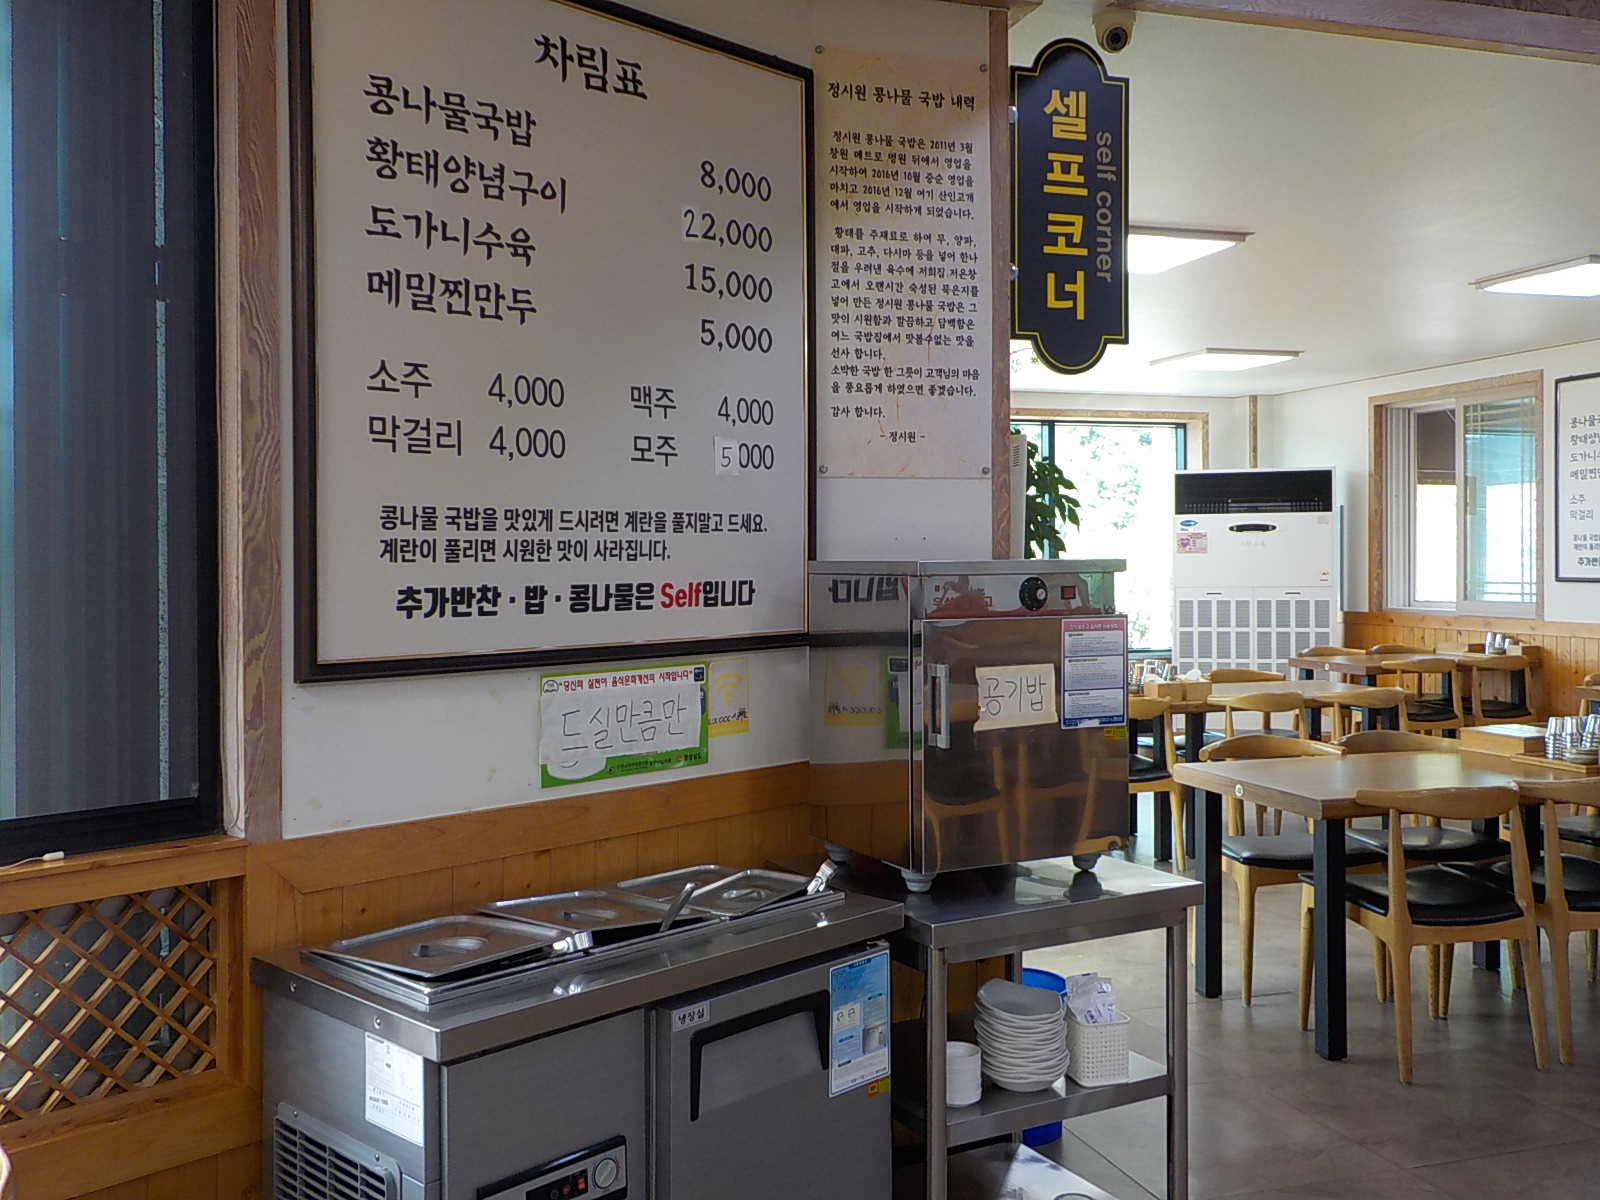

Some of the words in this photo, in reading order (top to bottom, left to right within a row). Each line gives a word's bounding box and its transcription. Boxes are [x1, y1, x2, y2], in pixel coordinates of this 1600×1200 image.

[534, 32, 648, 100] 차림표
[827, 82, 866, 101] 정시원
[873, 86, 913, 106] 콩나물
[919, 92, 945, 108] 국밥
[951, 95, 974, 111] 내력
[363, 73, 537, 148] 콩나물국밥
[832, 131, 861, 144] 정시원
[865, 135, 893, 147] 콩나물
[897, 137, 926, 149] 국밥은
[930, 140, 956, 153] 2011년
[960, 142, 973, 154] 3월
[829, 147, 848, 160] 창원
[854, 150, 883, 162] 메트로
[888, 152, 906, 165] 병원
[911, 155, 939, 167] 뒤에서
[944, 157, 972, 170] 영업을
[1096, 131, 1117, 183] self
[365, 136, 567, 214] 황태양념구이
[699, 159, 772, 203] 8,000
[829, 165, 867, 178] 시작하여
[872, 169, 899, 181] 2016년
[904, 171, 920, 183] 10월
[925, 173, 943, 185] 중순
[948, 174, 974, 187] 영업을
[829, 182, 858, 194] 마치고
[863, 185, 890, 197] 2016년
[895, 187, 912, 199] 12월
[917, 189, 933, 202] 여기
[938, 192, 974, 204] 산인고개
[1043, 89, 1089, 321] 셀프코너
[830, 199, 848, 211] 에서
[853, 201, 881, 214] 영업을
[885, 203, 922, 216] 시작하게
[926, 206, 974, 220] 되었습니다.
[364, 204, 536, 268] 도가니수육
[683, 208, 773, 253] 22,000
[834, 226, 864, 240] 황태를
[869, 229, 908, 242] 주재료로
[913, 232, 932, 245] 하여
[937, 234, 949, 246] 무,
[954, 234, 976, 248] 양파,
[1096, 190, 1113, 283] corner
[830, 244, 853, 257] 대파,
[857, 246, 879, 258] 고추,
[884, 247, 911, 260] 다시마
[916, 249, 934, 261] 등을
[939, 250, 955, 263] 넣어
[960, 252, 978, 264] 한나
[830, 261, 849, 273] 절을
[854, 262, 882, 275] 우려낸
[886, 264, 914, 277] 육수에
[919, 266, 945, 279] 저희집
[949, 268, 977, 280] 저온창
[684, 262, 773, 304] 15,000
[831, 278, 860, 291] 고에서
[865, 281, 904, 294] 오랜시간
[909, 283, 937, 295] 숙성된
[942, 285, 979, 298] 묵은지를
[366, 267, 538, 326] 메밀찐만두
[831, 296, 848, 308] 넣어
[853, 297, 872, 309] 만든
[876, 299, 902, 310] 정시원
[906, 301, 933, 312] 콩나물
[938, 301, 965, 314] 국밥은
[968, 303, 978, 313] 그
[831, 313, 850, 325] 맛의
[854, 315, 892, 326] 시원함과
[896, 316, 934, 328] 깔끔하고
[938, 318, 975, 331] 담백함은
[700, 318, 773, 354] 5,000
[831, 330, 850, 342] 어느
[854, 331, 900, 344] 국밥집에서
[906, 333, 951, 346] 맛볼수없는
[956, 336, 974, 348] 맛을
[831, 348, 850, 359] 선사
[854, 348, 886, 360] 합니다.
[365, 358, 433, 399] 소주
[487, 372, 566, 409] 4,000
[830, 365, 859, 376] 소박한
[862, 365, 881, 378] 국밥
[884, 367, 893, 378] 한
[896, 367, 922, 380] 그릇이
[926, 368, 959, 381] 고객님의
[963, 369, 980, 381] 마음
[831, 382, 840, 394] 을
[845, 382, 882, 394] 풍요롭게
[887, 384, 924, 396] 하였으면
[928, 384, 976, 397] 좋겠습니다.
[630, 384, 677, 421] 맥주
[717, 395, 775, 427] 4,000
[831, 406, 850, 418] 감사
[854, 407, 886, 419] 합니다.
[368, 414, 463, 457] 막걸리
[488, 425, 566, 462] 4,000
[889, 431, 916, 443] 정시원
[630, 434, 679, 467] 모주
[1570, 494, 1586, 504] 소주
[379, 505, 438, 531] 콩나물
[444, 506, 498, 532] 국밥을
[504, 508, 553, 532] 맛있게
[558, 509, 619, 533] 드시려면
[624, 510, 667, 533] 계란을
[672, 511, 723, 533] 풀지말고
[728, 513, 767, 534] 드세요.
[1570, 509, 1593, 520] 막걸리
[379, 538, 437, 563] 계란이
[444, 538, 496, 563] 풀리면
[503, 538, 552, 563] 시원한
[557, 539, 588, 562] 맛이
[593, 539, 670, 562] 사라집니다.
[1578, 557, 1600, 566] 추가반
[396, 584, 501, 619] 추가반찬
[569, 582, 654, 613] 콩나물은
[588, 680, 607, 689] 실천이
[983, 674, 1046, 715] 공기밥
[562, 693, 687, 751] 드실만큼만
[678, 1008, 704, 1025] 냉장실
